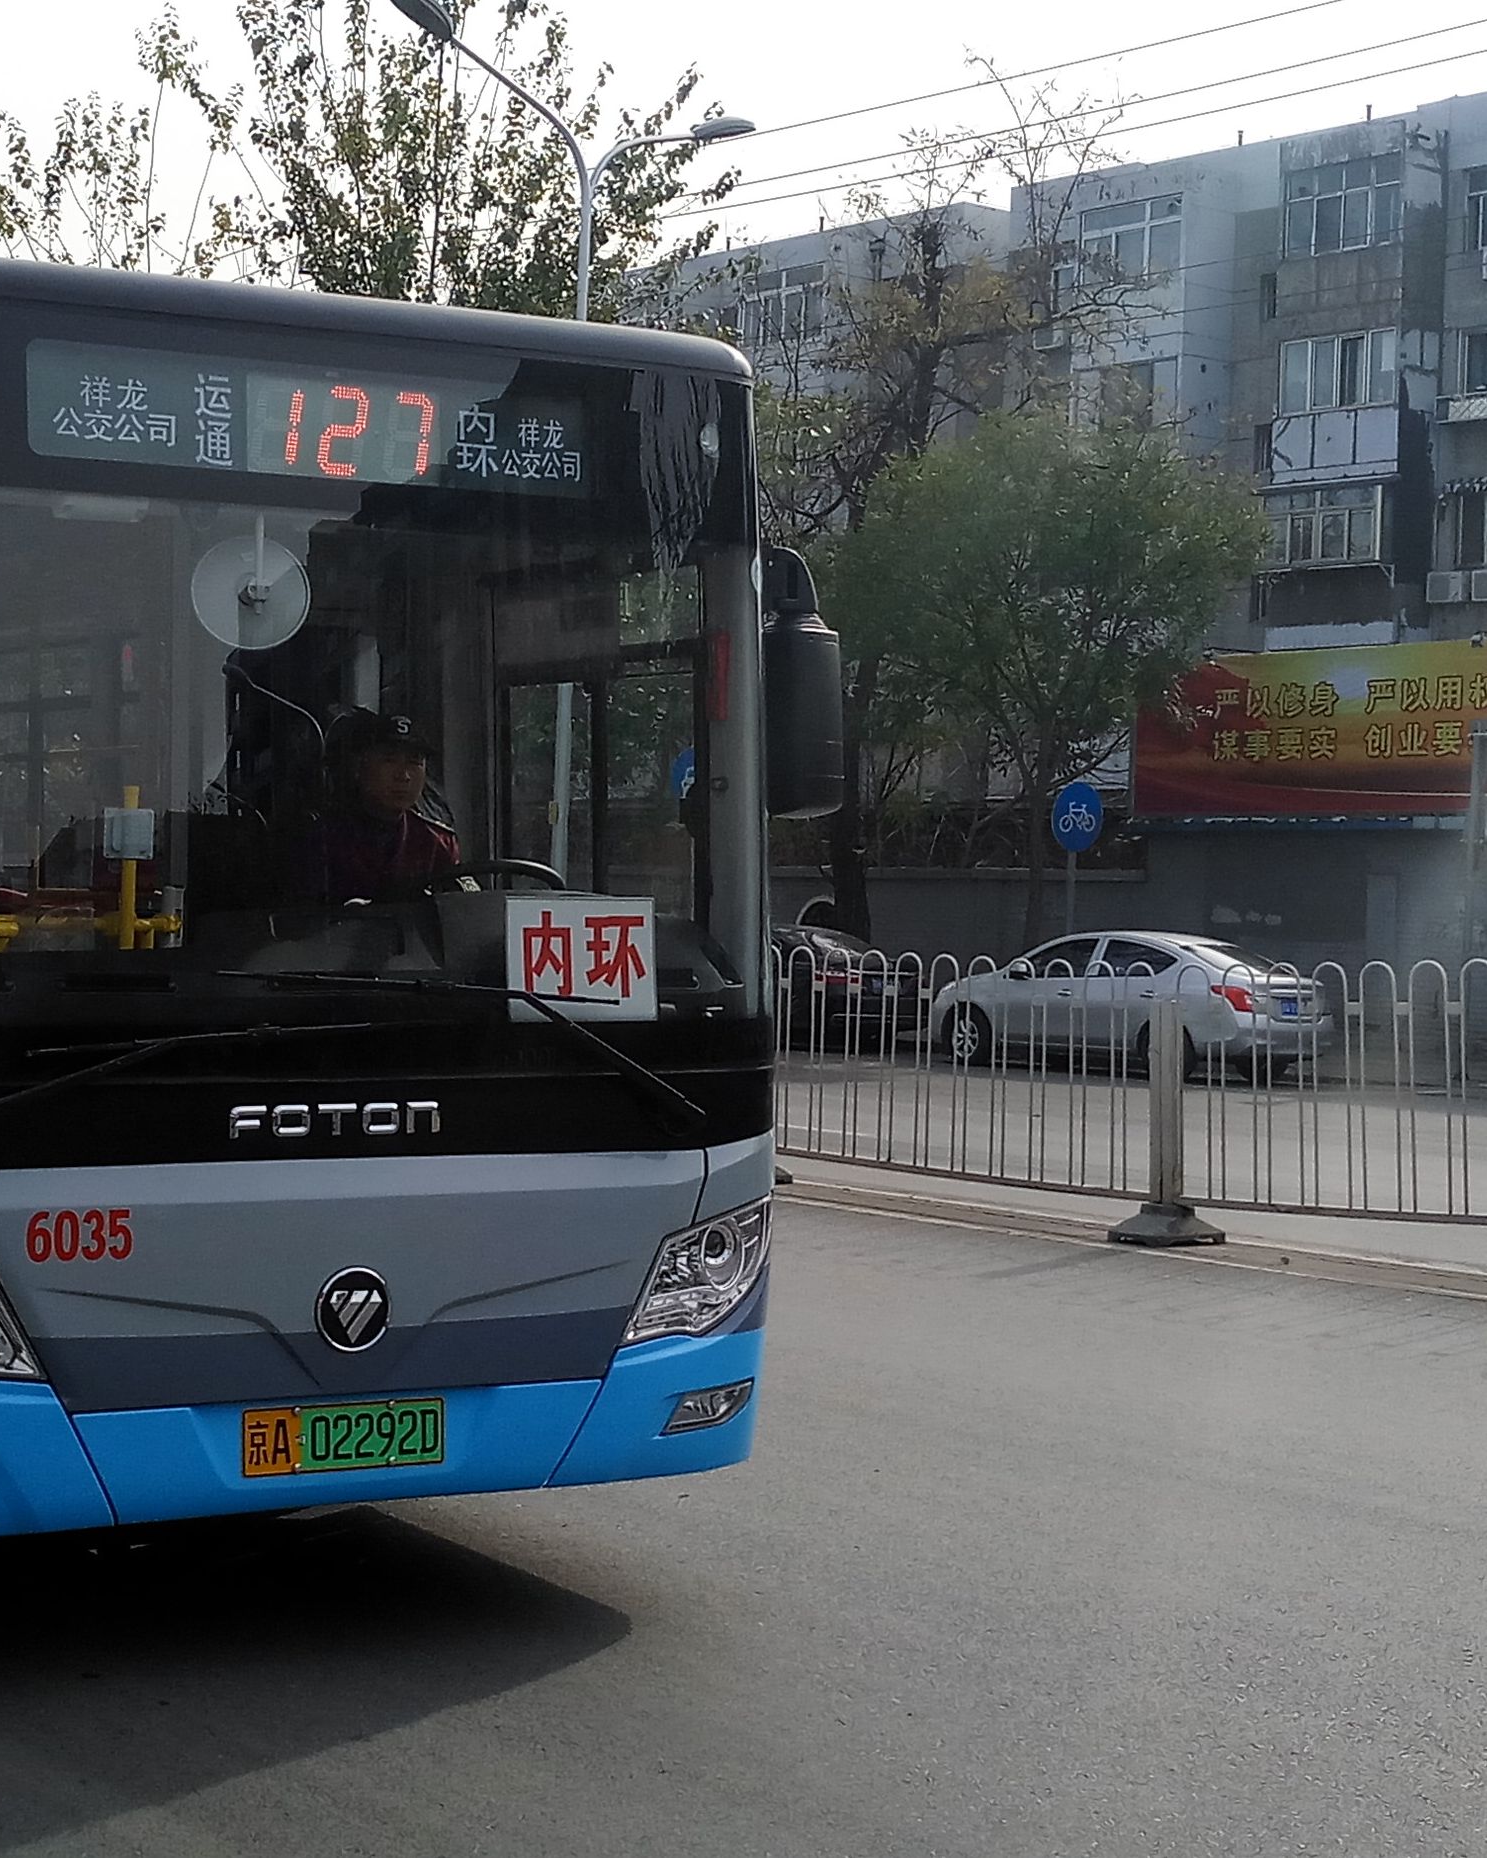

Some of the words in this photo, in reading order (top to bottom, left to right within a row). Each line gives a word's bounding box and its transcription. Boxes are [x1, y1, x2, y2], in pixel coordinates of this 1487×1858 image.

[79, 374, 149, 412] 祥龙
[52, 405, 178, 448] 公交公司
[285, 384, 434, 477] 127
[517, 415, 565, 450] 祥龙
[501, 446, 583, 484] 公交公司
[1214, 680, 1340, 719] 严以修身
[1213, 726, 1339, 762] 谋事要实
[1363, 720, 1475, 758] 创业要
[522, 910, 646, 998] 内环
[228, 1100, 441, 1138] FOTON
[25, 1208, 134, 1264] 6035
